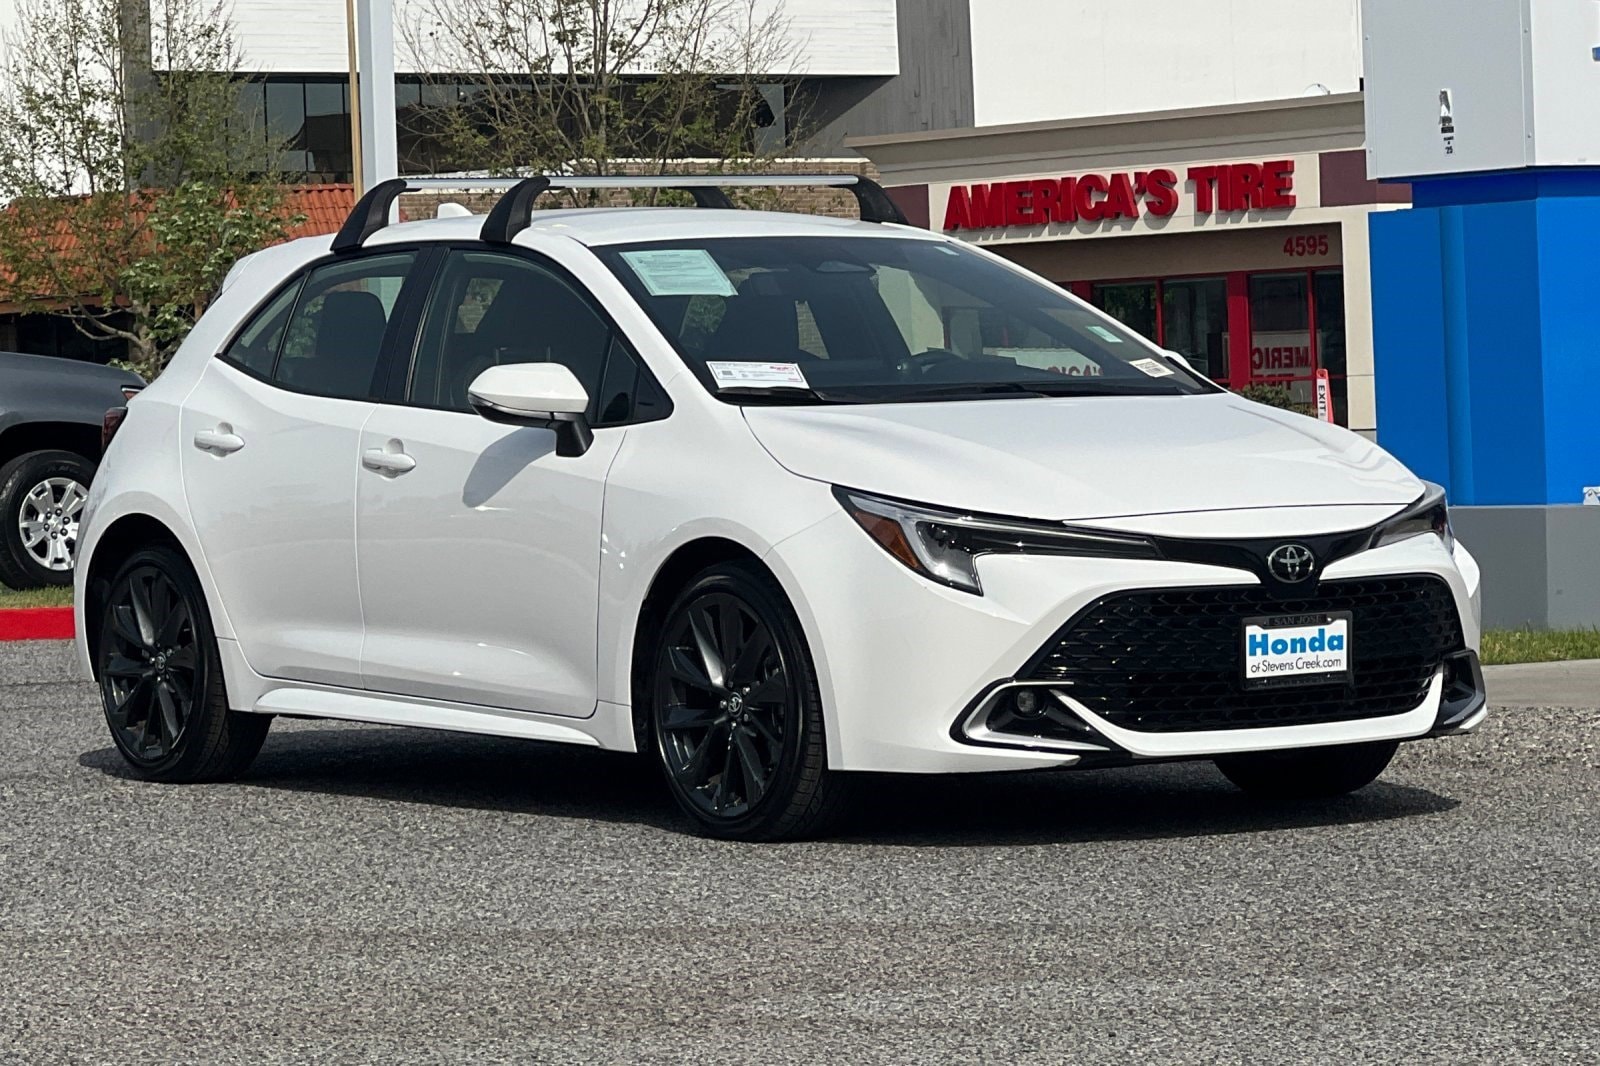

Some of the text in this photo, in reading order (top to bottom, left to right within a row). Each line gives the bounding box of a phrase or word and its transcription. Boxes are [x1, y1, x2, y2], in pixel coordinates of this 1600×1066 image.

[943, 159, 1297, 231] AMERICA'S TIRE
[1283, 235, 1329, 257] 4595
[1273, 614, 1321, 625] SAN JOSE
[1248, 628, 1344, 656] Honda
[1250, 654, 1342, 673] of Stevens Creek.com
